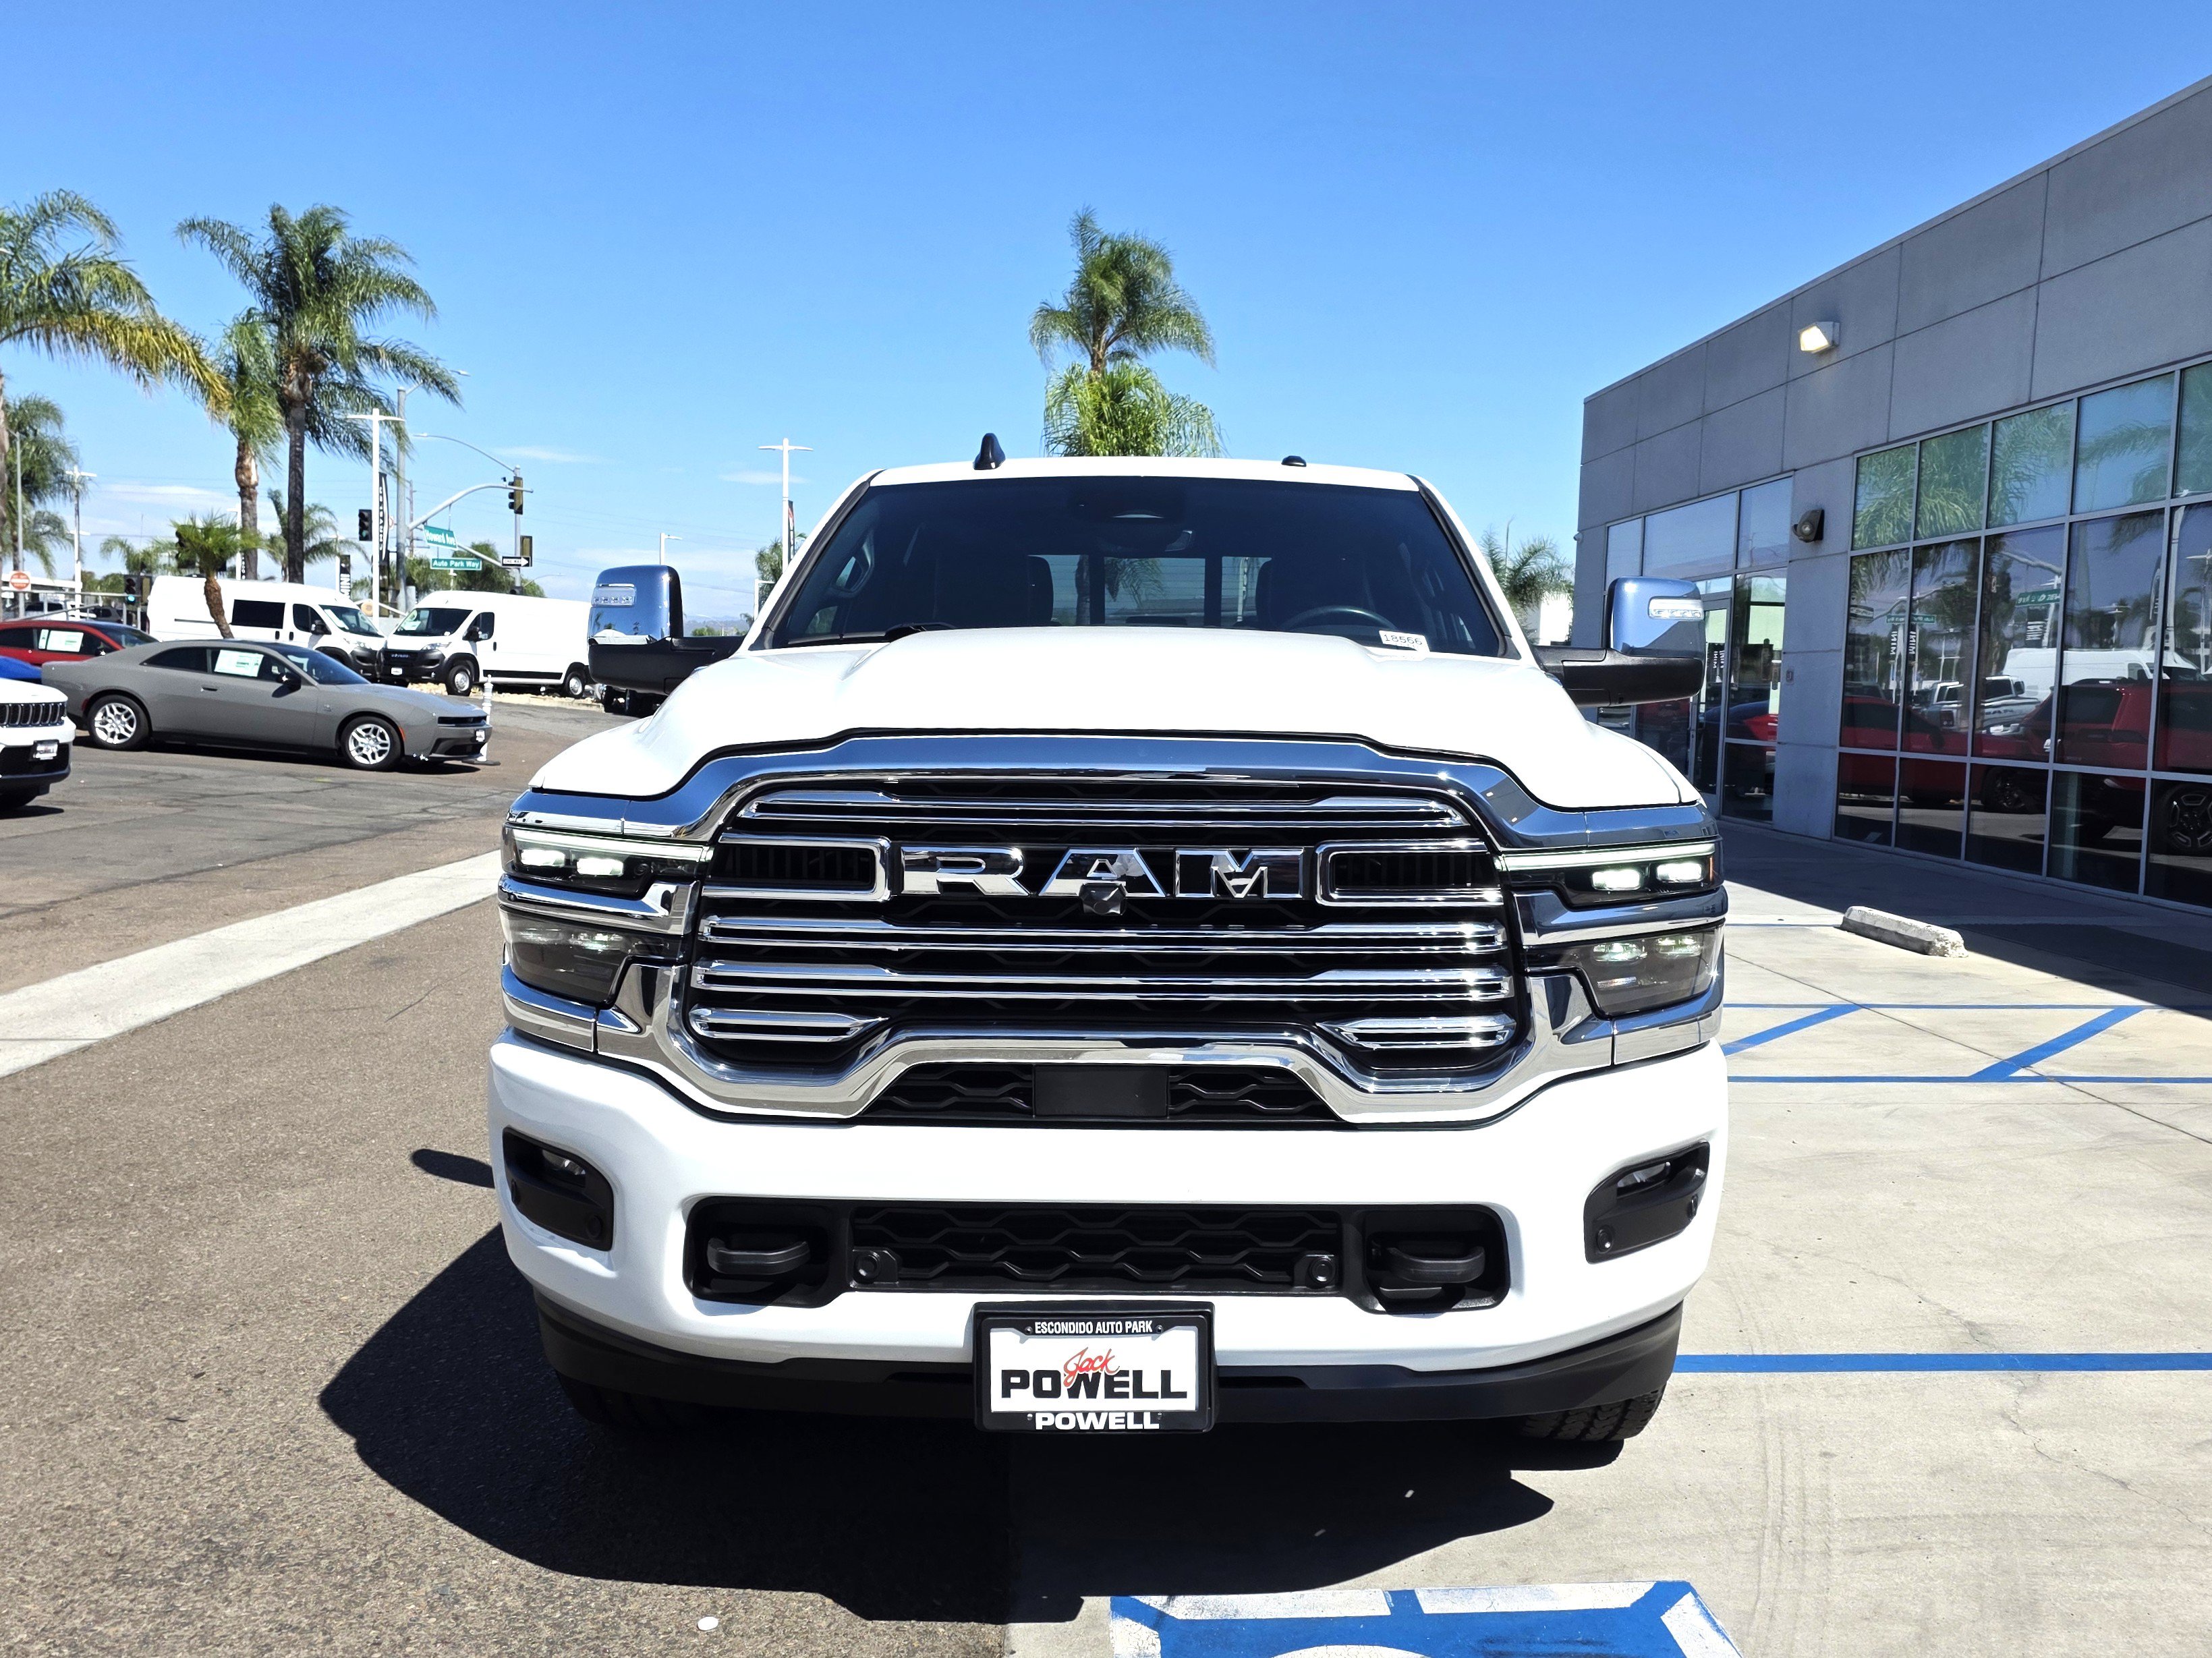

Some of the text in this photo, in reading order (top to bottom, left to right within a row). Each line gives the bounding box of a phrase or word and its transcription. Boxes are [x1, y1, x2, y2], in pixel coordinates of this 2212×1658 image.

[425, 530, 445, 544] Howard
[1384, 634, 1423, 646] 18566
[901, 846, 1305, 898] RAM
[1034, 1320, 1153, 1335] ESCONDIDO AUTO PARK
[1062, 1346, 1120, 1388] Jack
[1000, 1369, 1187, 1400] POWELL
[1035, 1412, 1160, 1430] POWELL
